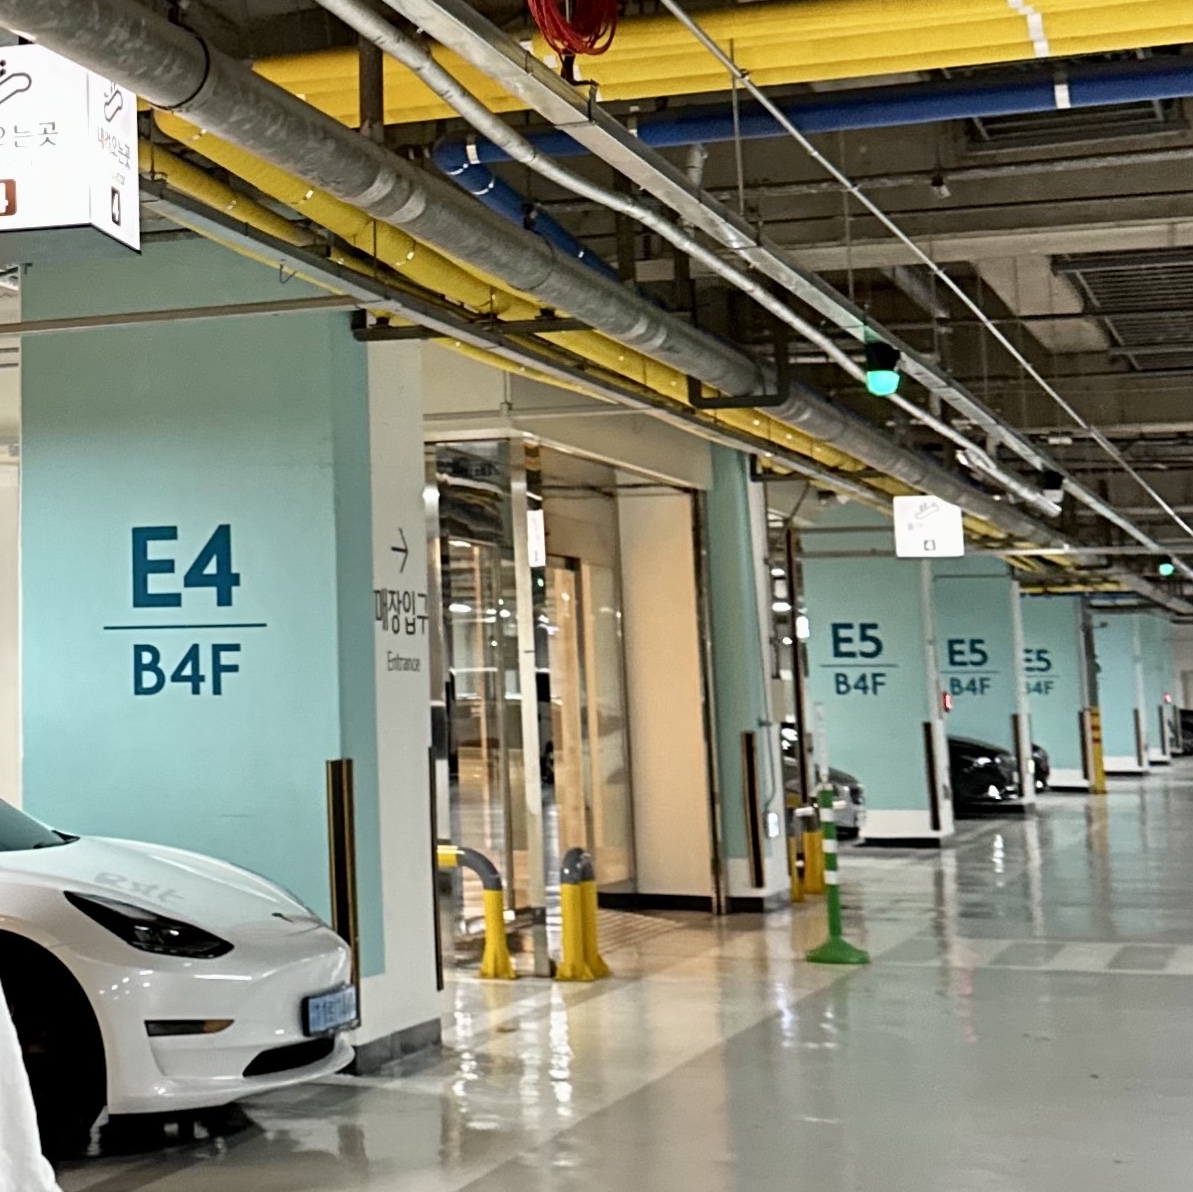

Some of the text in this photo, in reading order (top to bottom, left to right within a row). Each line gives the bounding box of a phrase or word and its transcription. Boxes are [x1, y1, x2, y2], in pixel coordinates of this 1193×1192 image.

[131, 523, 241, 608] E4
[831, 622, 884, 659] E5
[947, 638, 988, 667] E5
[132, 642, 242, 696] B4F
[387, 650, 421, 672] Entrance
[834, 672, 887, 696] B4F
[949, 677, 991, 696] B4F
